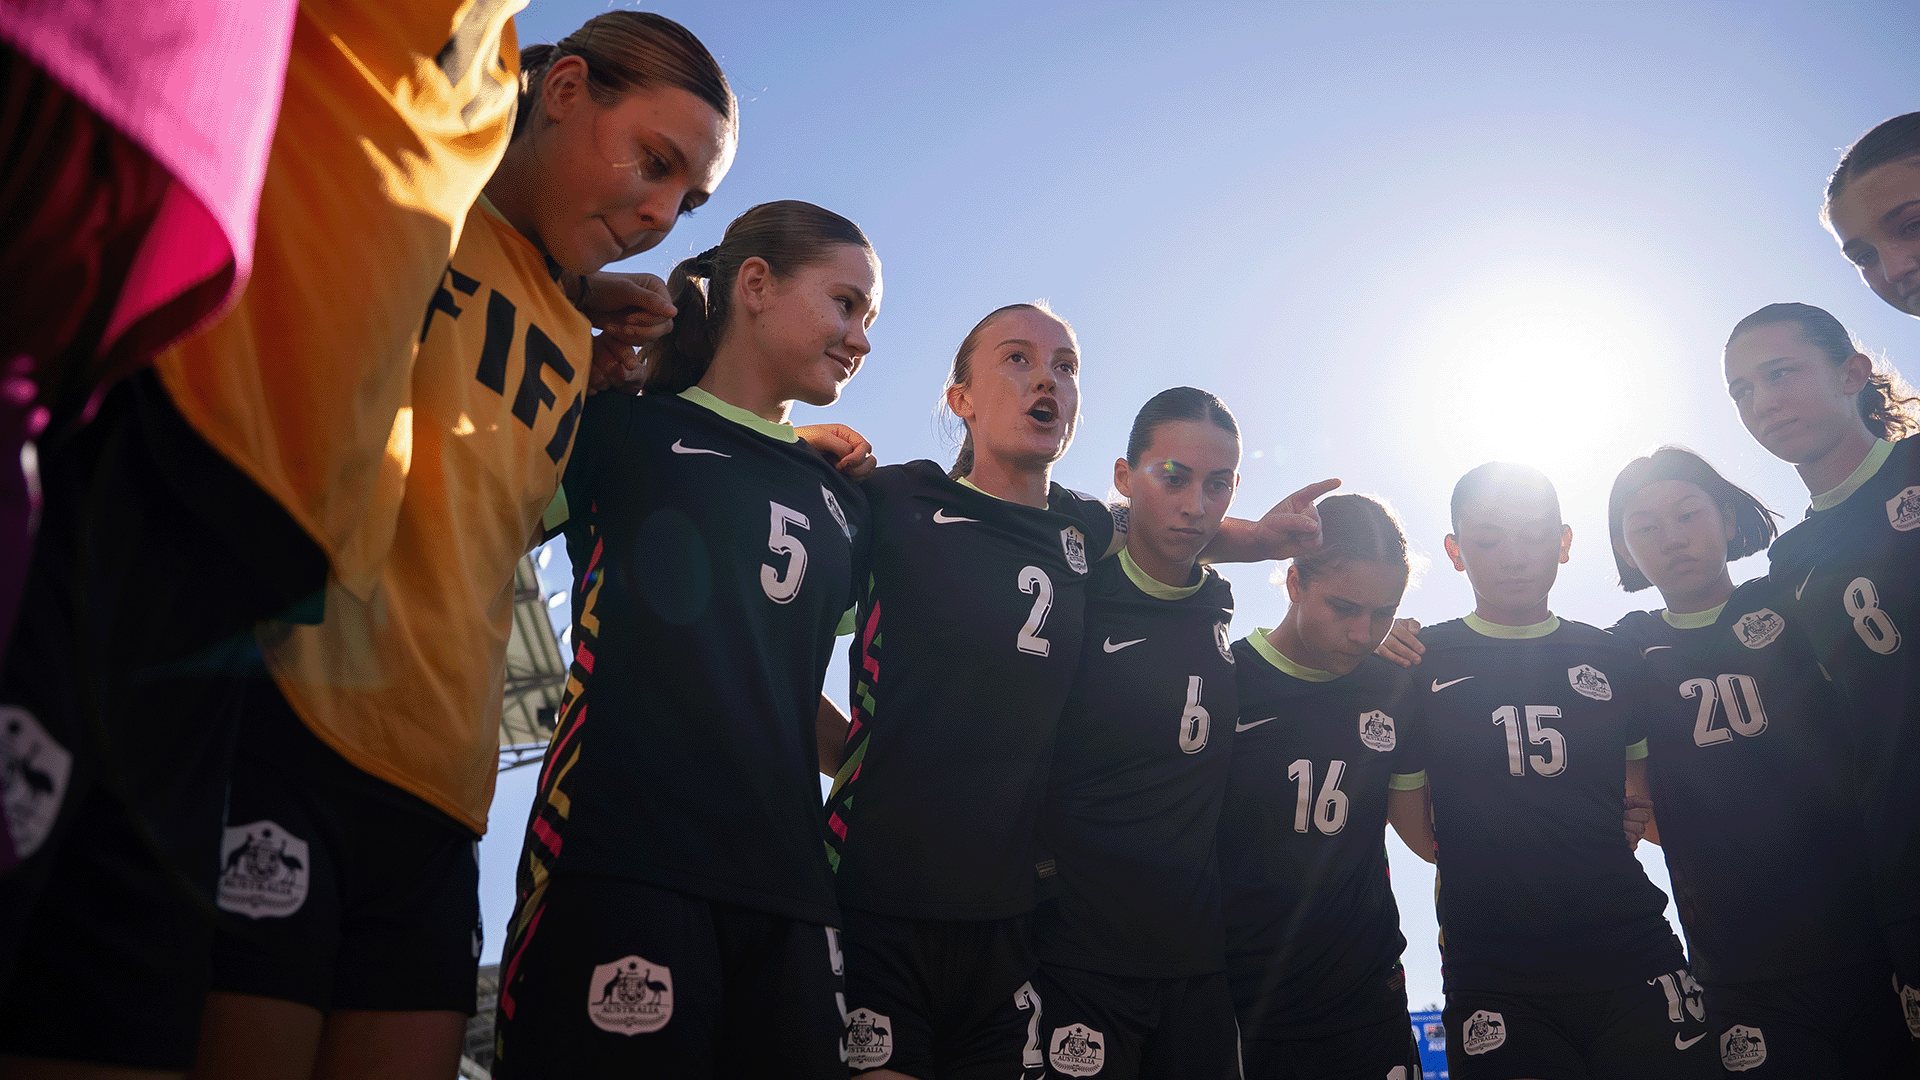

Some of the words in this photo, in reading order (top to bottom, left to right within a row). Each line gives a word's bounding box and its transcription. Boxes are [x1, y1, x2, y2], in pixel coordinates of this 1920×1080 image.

[760, 501, 811, 605] 5
[1017, 565, 1054, 657] 2
[1843, 577, 1902, 656] 8
[1178, 675, 1212, 754] 6
[1492, 705, 1568, 778] 15
[1679, 673, 1769, 748] 20
[1288, 759, 1350, 836] 16
[601, 1004, 660, 1014] AUSTRALIA
[1013, 980, 1044, 1069] 2
[1468, 1035, 1499, 1047] AUSTRALIA
[1057, 1055, 1096, 1065] AUSTRALIA
[1727, 1051, 1760, 1061] AUSTRALIA
